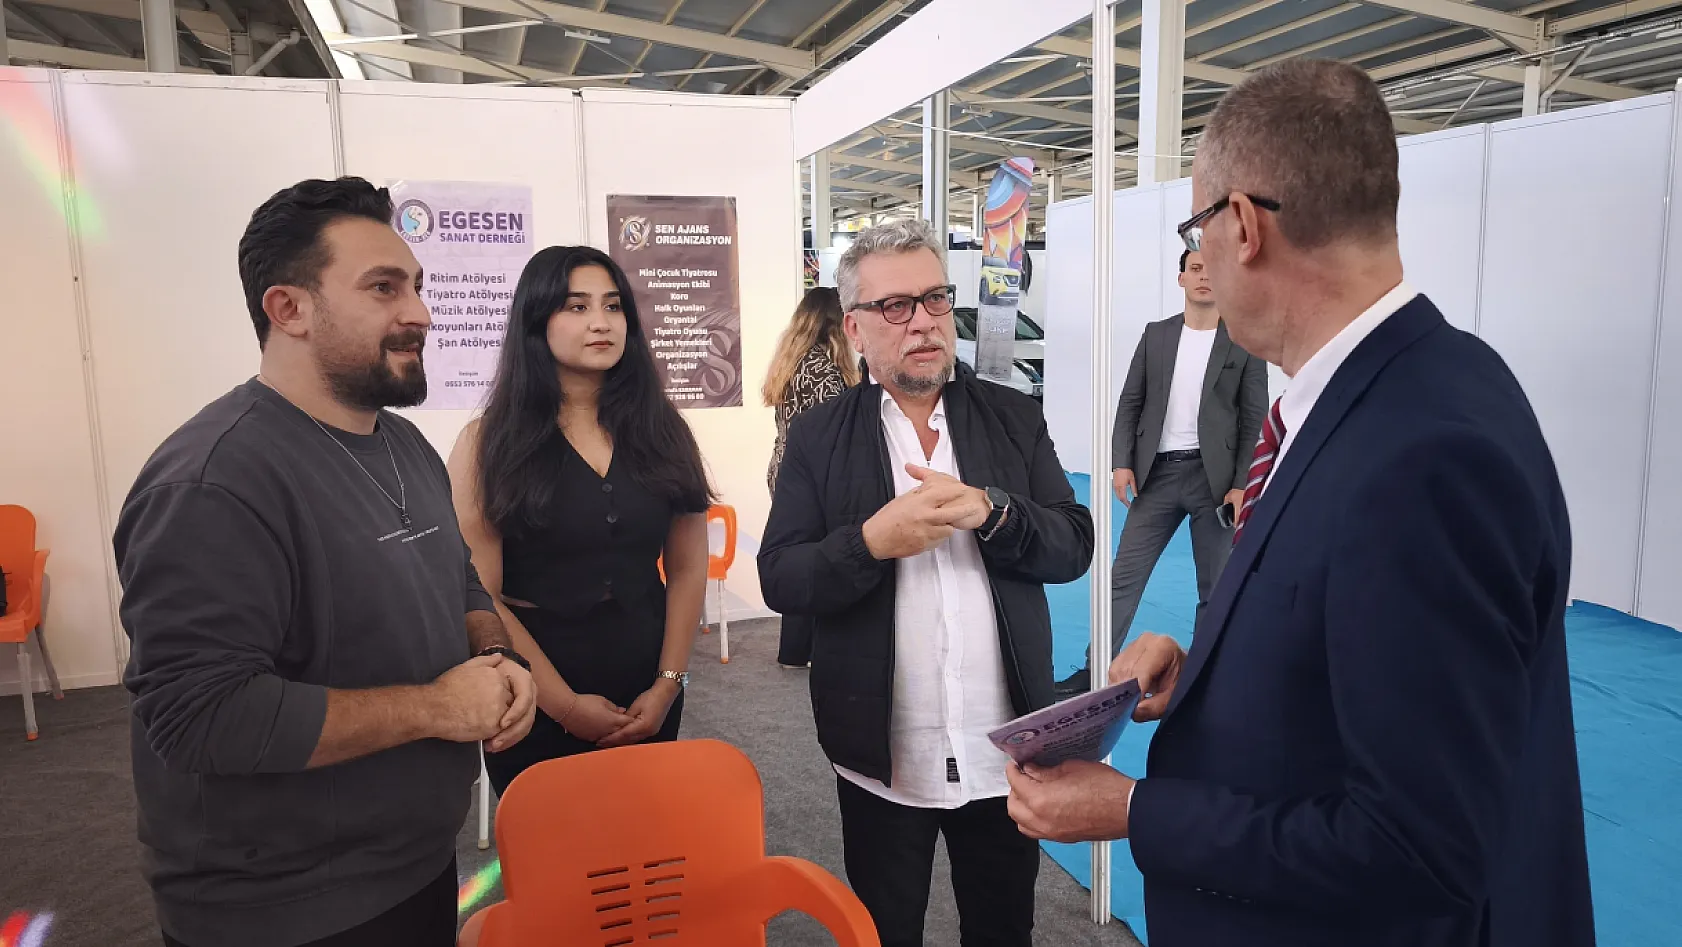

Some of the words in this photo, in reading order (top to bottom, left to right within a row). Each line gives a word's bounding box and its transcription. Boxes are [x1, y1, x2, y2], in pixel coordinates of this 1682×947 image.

[438, 211, 523, 231] EGESEN
[655, 224, 675, 234] SEN
[677, 224, 710, 234] AJANS
[439, 232, 475, 243] SANAT
[478, 232, 526, 244] DERNEĞİ
[655, 235, 732, 245] ORGANİZASYON
[639, 268, 656, 277] Mini
[657, 268, 680, 278] Çocuk
[681, 268, 718, 278] Tiyatrosu
[430, 273, 459, 283] Ritim
[461, 273, 507, 285] Atölyesi
[647, 280, 690, 290] Animasyon
[691, 280, 711, 288] Ekibi
[427, 288, 466, 301] Tiyatro
[469, 289, 514, 301] Atölyesi
[431, 304, 463, 316] Müzik
[654, 304, 672, 312] Halk
[673, 304, 705, 313] Oyunları
[663, 316, 697, 325] Oryantal
[653, 328, 682, 337] Tiyatro
[683, 328, 708, 337] Oyunu
[437, 338, 457, 349] Şan
[650, 339, 674, 348] Şirket
[674, 337, 713, 346] Yemekleri
[655, 350, 708, 359] Organizasyon
[667, 362, 698, 371] Açılışlar
[1043, 690, 1133, 730] EGESEN
